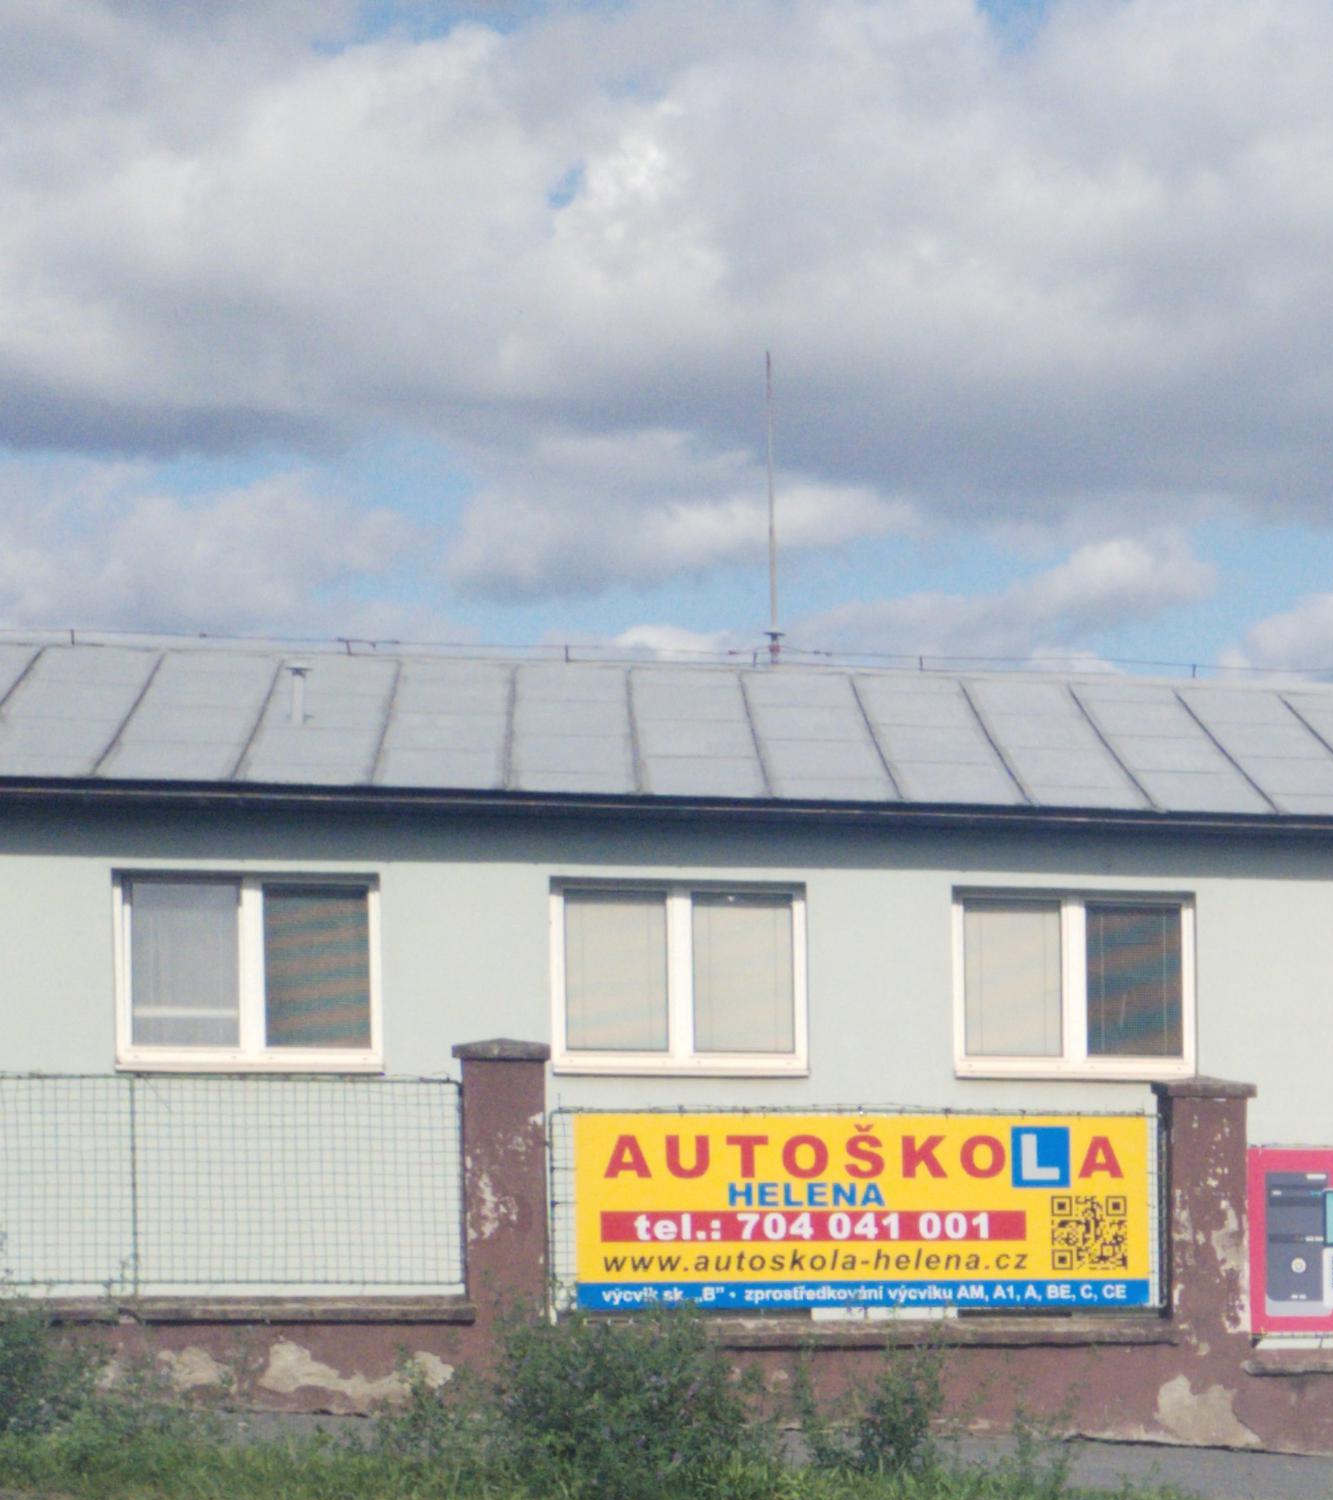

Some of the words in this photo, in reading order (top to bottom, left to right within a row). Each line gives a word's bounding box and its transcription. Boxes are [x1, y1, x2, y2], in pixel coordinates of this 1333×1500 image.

[604, 1124, 1124, 1180] AUTOŠKOLA
[728, 1182, 885, 1207] HELENA
[633, 1213, 722, 1241] tel.:
[736, 1212, 814, 1240] 704
[828, 1212, 900, 1240] 041
[918, 1212, 990, 1240] 001
[603, 1248, 1028, 1272] www.autoskola-helena.cz
[888, 1285, 953, 1303] výcviku
[956, 1285, 989, 1302] AM,
[993, 1285, 1021, 1301] A1,
[1024, 1285, 1042, 1301] A,
[1046, 1284, 1077, 1301] BE,
[1080, 1284, 1098, 1300] C,
[1102, 1284, 1127, 1299] CE
